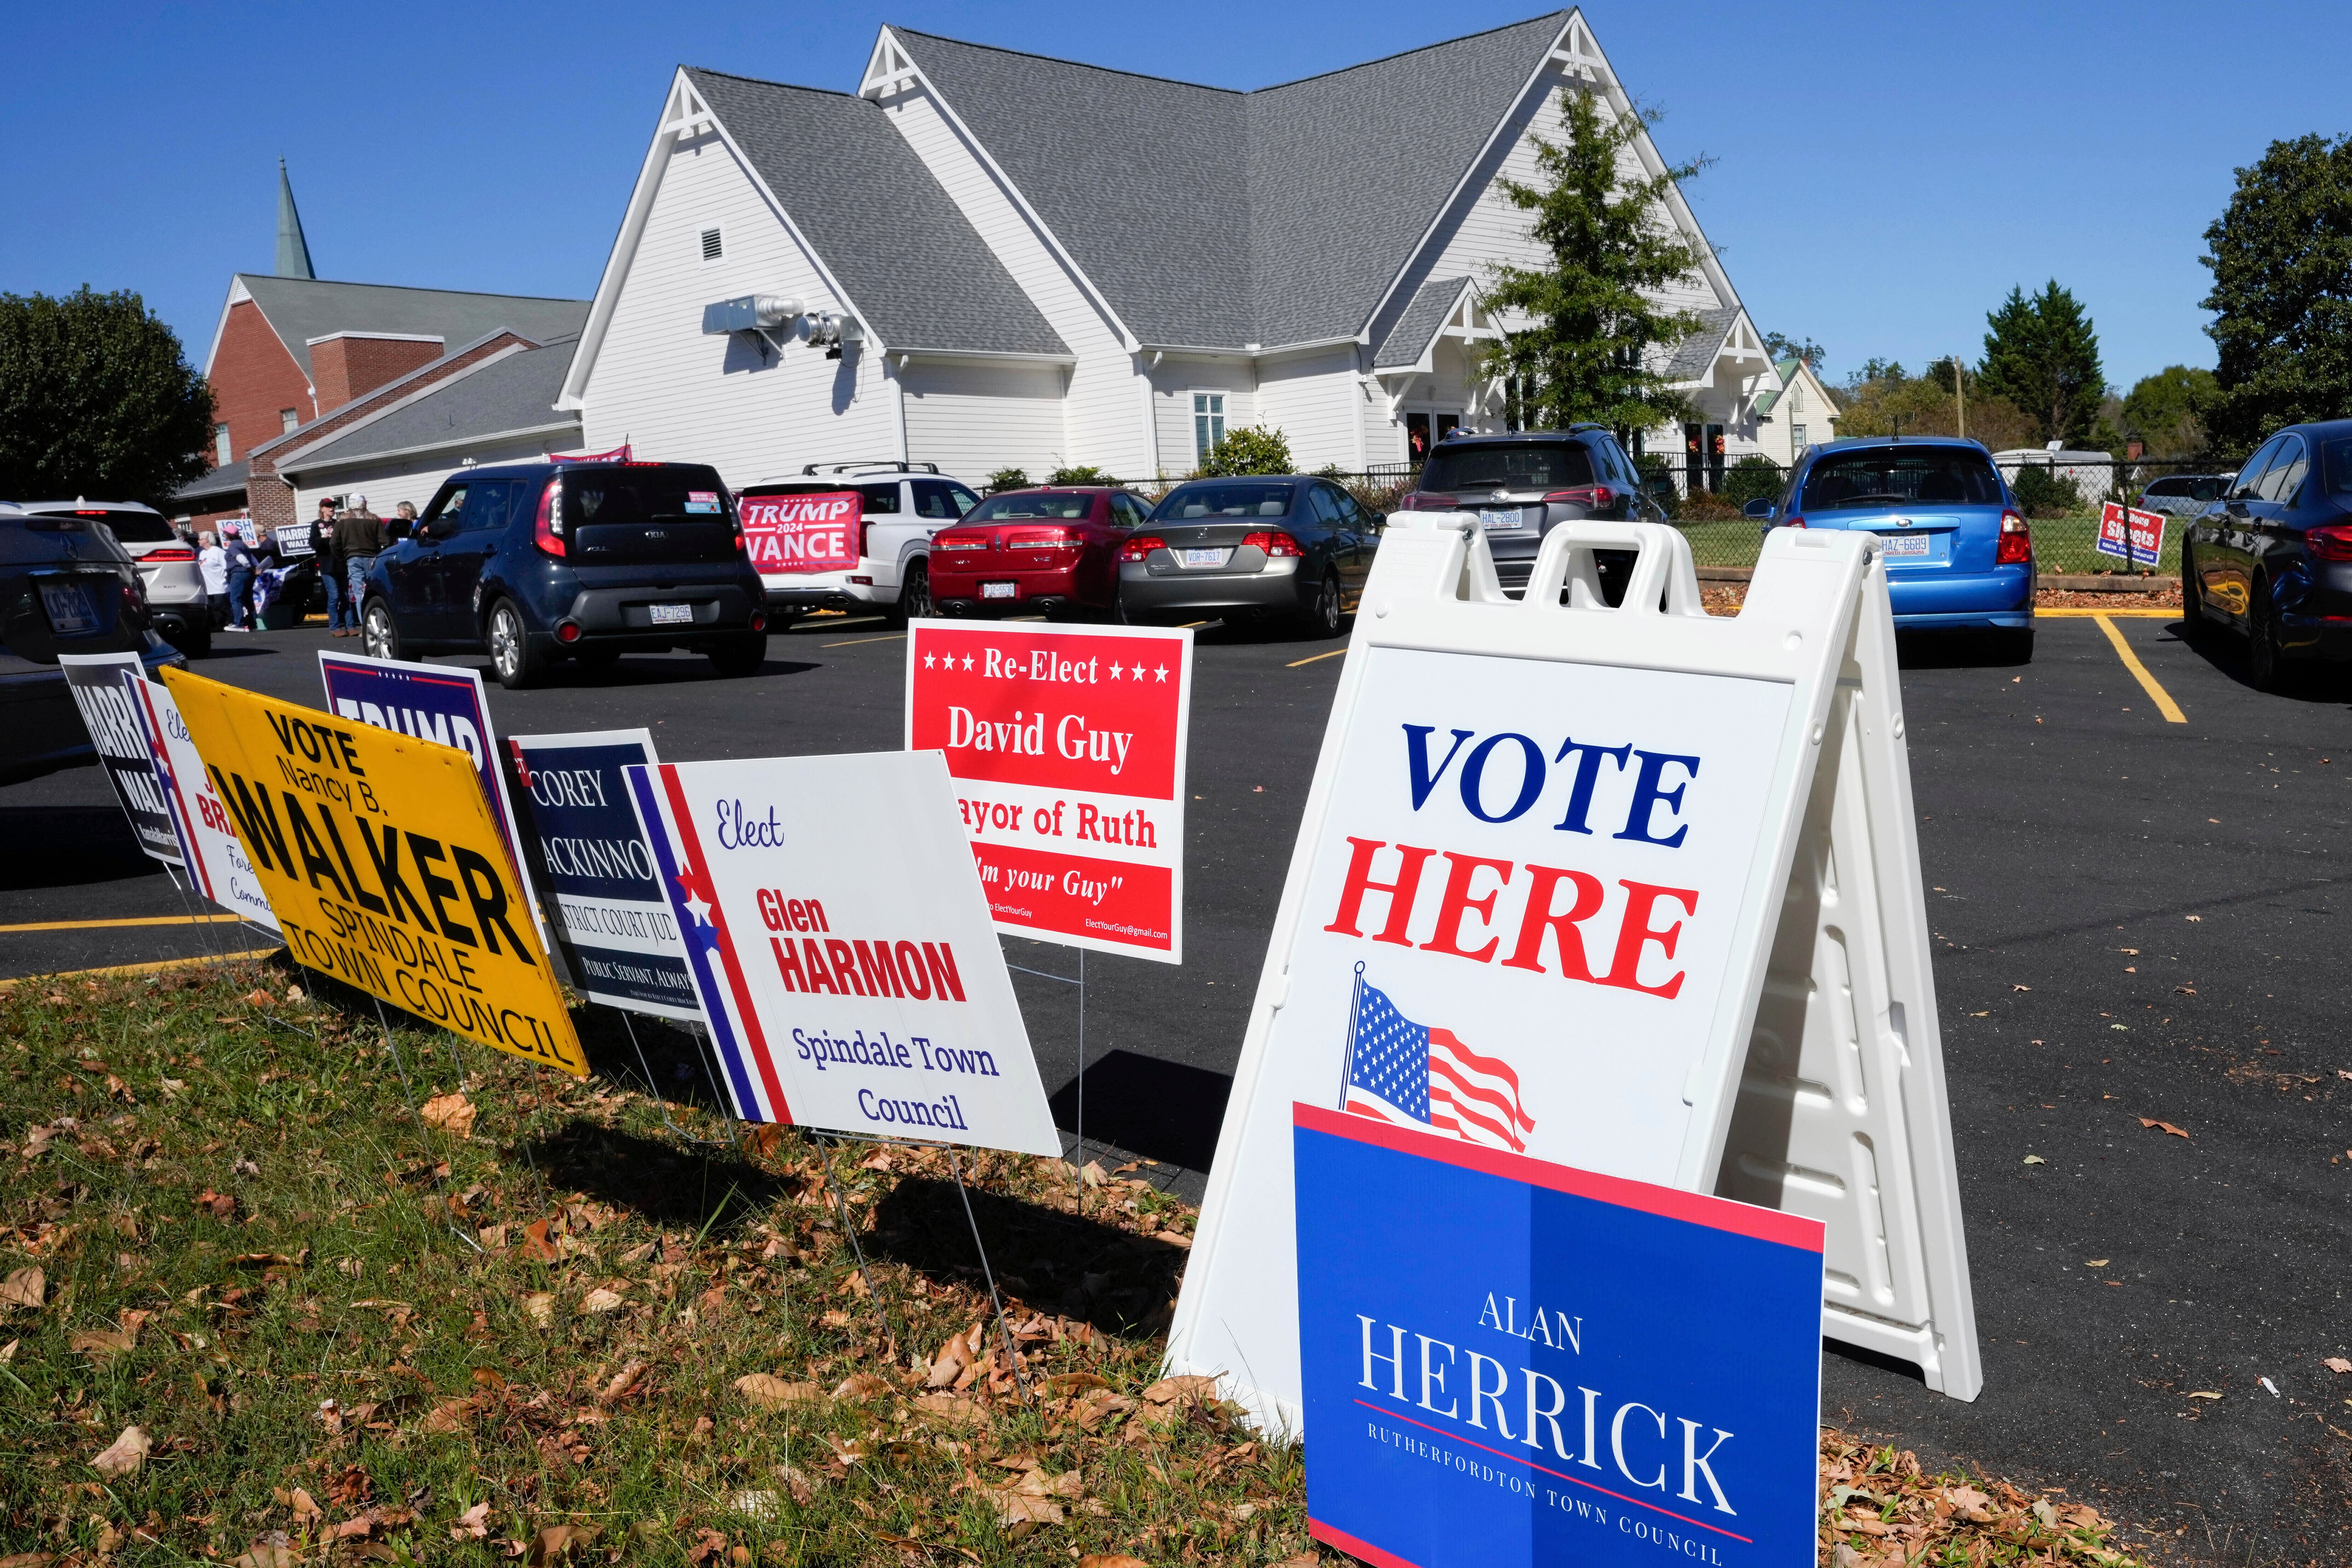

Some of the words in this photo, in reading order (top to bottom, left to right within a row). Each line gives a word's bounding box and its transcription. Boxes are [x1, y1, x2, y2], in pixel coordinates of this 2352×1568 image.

[749, 501, 849, 524] TRUMP
[777, 523, 803, 533] 2024
[1483, 512, 1519, 523] HAL-2800
[2107, 520, 2155, 547] Shets
[279, 527, 311, 541] HARRIS
[287, 539, 309, 548] WALZ
[746, 532, 844, 561] VANCE
[1882, 538, 1926, 550] HAZ-6689
[1189, 552, 1220, 561] VDR-7617
[985, 586, 1013, 594] PJZ-5536
[651, 607, 690, 619] EAJ-7296
[983, 648, 1098, 684] Re-Elect
[72, 685, 147, 759] HARRI
[265, 710, 365, 776] VOTE
[948, 706, 1045, 755] David
[1057, 714, 1133, 775] Guy
[276, 755, 351, 812] Nancy
[359, 782, 388, 816] B.
[528, 770, 609, 807] COREY
[1402, 723, 1700, 848] VOTE
[717, 799, 784, 850] Elect
[957, 798, 1023, 834] ayor
[1033, 800, 1066, 837] of
[1077, 803, 1157, 849] Ruth
[207, 763, 537, 966] WALKER
[227, 845, 254, 874] Fore
[541, 836, 653, 880] ACKINNO
[1005, 869, 1055, 892] your
[1063, 870, 1123, 906] Guy"
[549, 902, 603, 933] DISTRICT
[602, 908, 649, 939] COURT
[646, 912, 677, 947] JUD
[756, 888, 830, 933] Glen
[995, 903, 1032, 918] ElectYourGuy
[1086, 918, 1168, 939] ElectYourGuy@gmail.com
[1323, 836, 1699, 1000] HERE
[319, 897, 483, 993] SPINDALE
[582, 957, 616, 979] PUBLIC
[613, 961, 658, 988] SERVANT,
[769, 937, 966, 1002] HARMON
[279, 918, 391, 997] TOWN
[395, 970, 574, 1066] COUNCIL
[792, 1027, 912, 1071] Spindale
[912, 1037, 1000, 1077] Town
[858, 1089, 967, 1130] Council
[1478, 1291, 1582, 1356] ALAN
[1356, 1313, 1737, 1516] HERRICK
[1368, 1422, 1536, 1500] RUTHERFORDTON
[1547, 1489, 1608, 1525] TOWN
[1620, 1515, 1722, 1567] COUNCIL
